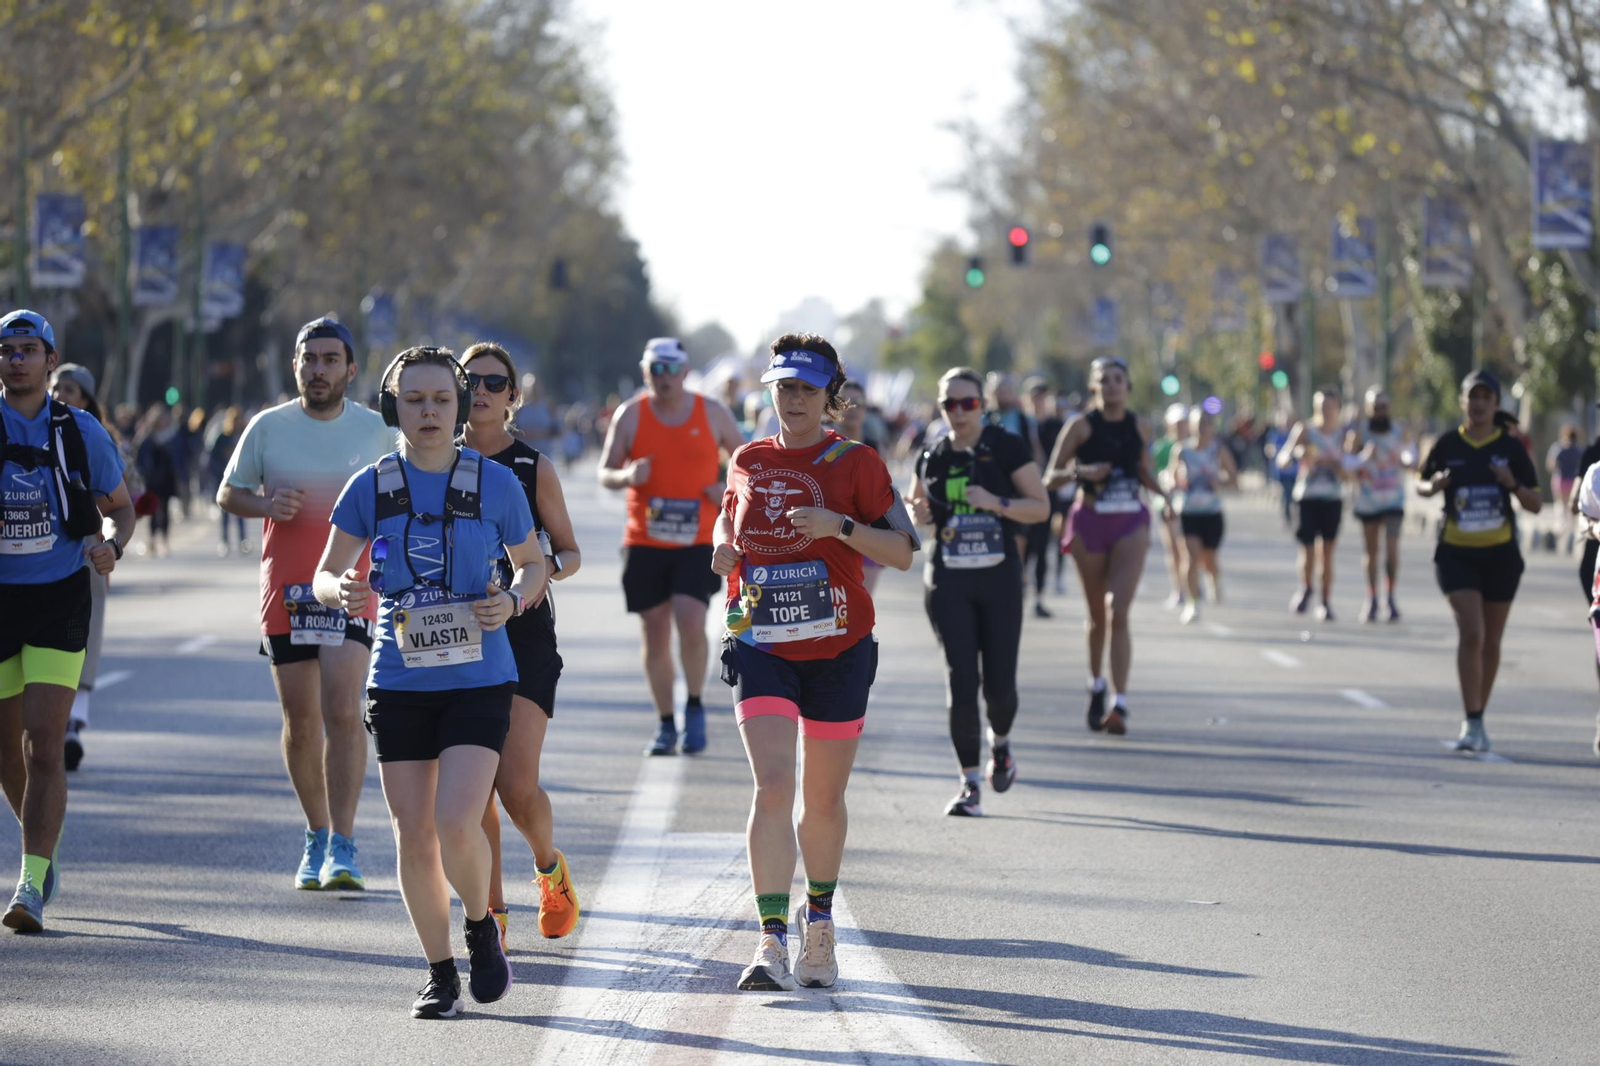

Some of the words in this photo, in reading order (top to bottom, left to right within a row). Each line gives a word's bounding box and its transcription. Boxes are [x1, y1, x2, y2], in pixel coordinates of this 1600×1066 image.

[4, 490, 41, 500] ZURICH
[3, 511, 30, 520] 13663
[452, 510, 474, 518] EVADICT
[958, 542, 989, 555] OLGA
[772, 566, 817, 580] ZURICH
[772, 591, 802, 603] 14121
[421, 612, 453, 626] 12430
[770, 605, 810, 624] TOPE
[290, 615, 302, 628] M.
[409, 627, 469, 648] VLASTA
